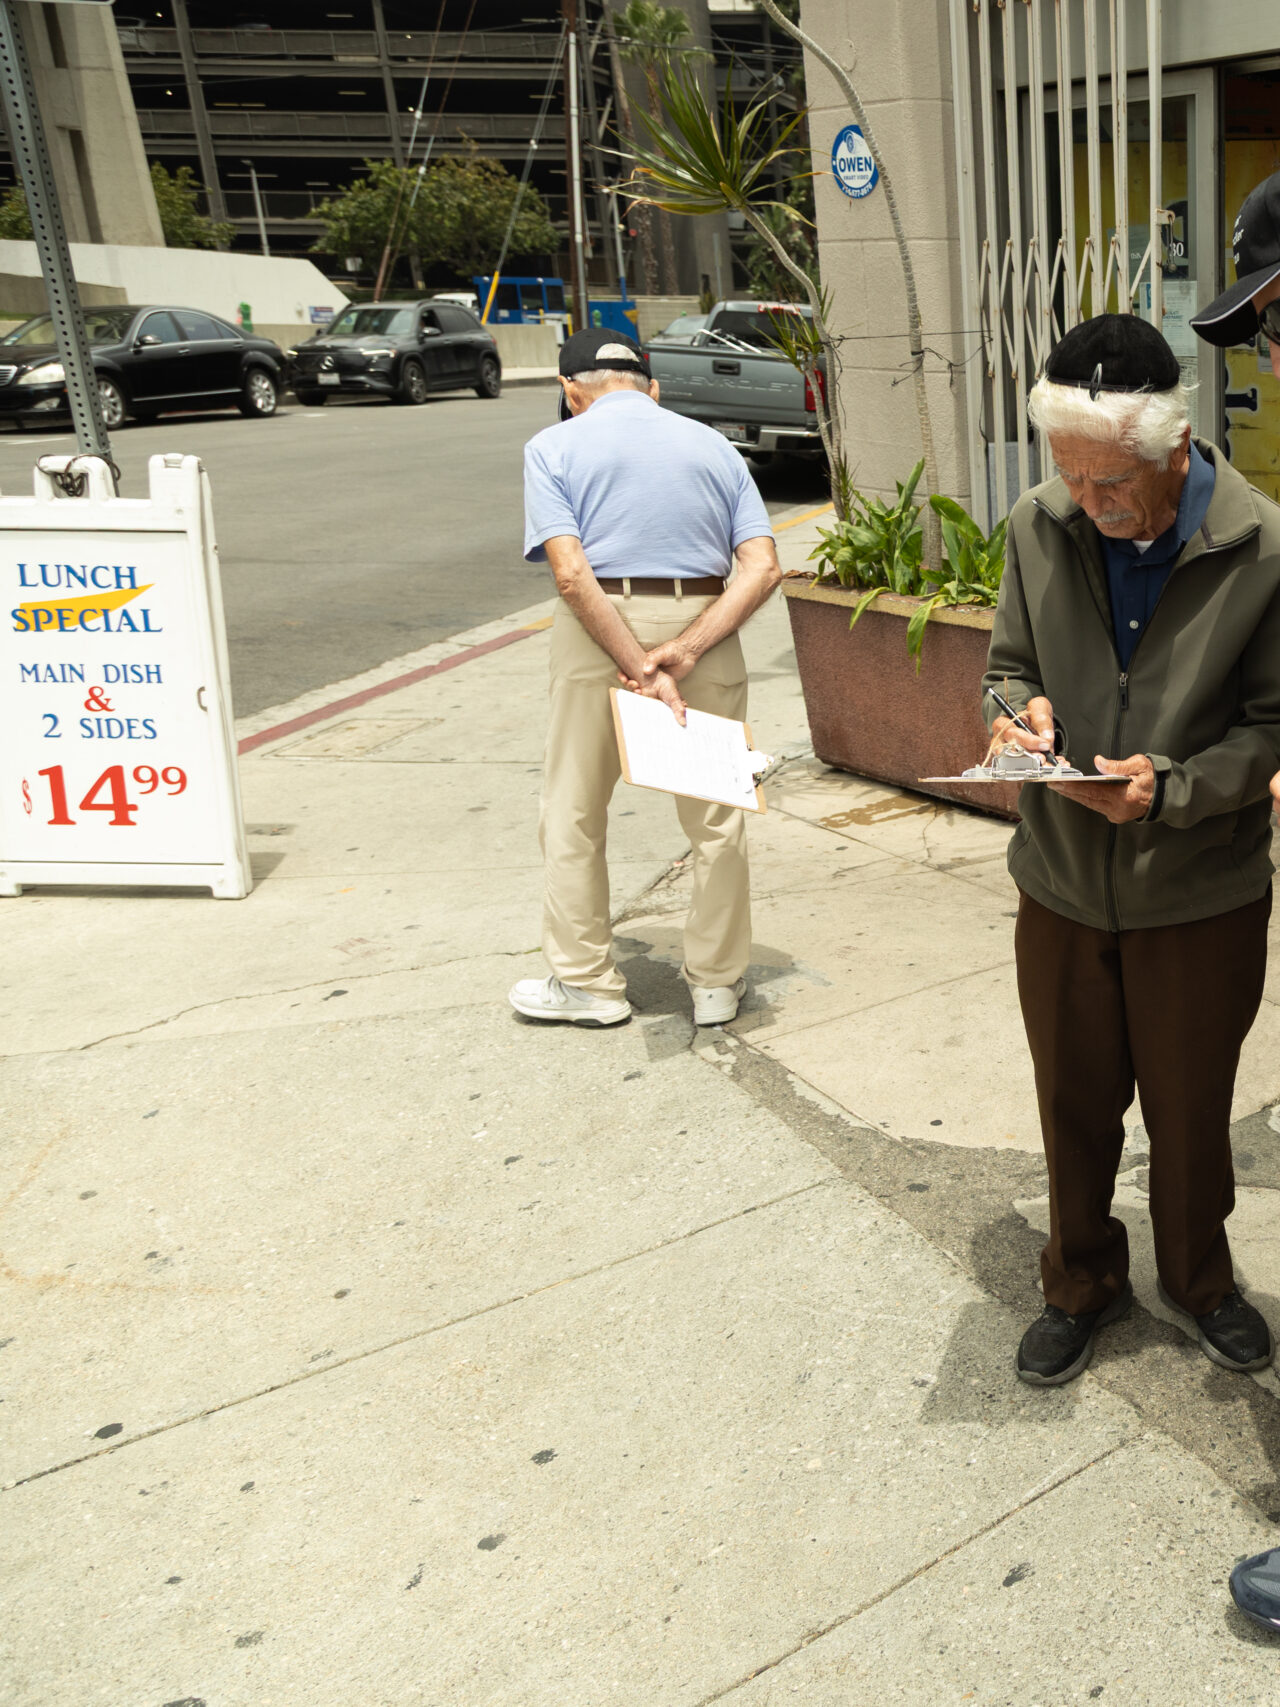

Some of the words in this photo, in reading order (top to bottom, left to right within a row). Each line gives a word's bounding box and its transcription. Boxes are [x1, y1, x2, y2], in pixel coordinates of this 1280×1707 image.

[839, 156, 872, 172] OWEN
[17, 563, 139, 589] LUNCH
[12, 608, 163, 633] SPECIAL
[19, 663, 85, 683] MAIN
[103, 664, 163, 683] DISH
[84, 686, 115, 712] &
[42, 714, 62, 739] 2
[80, 718, 157, 740] SIDES
